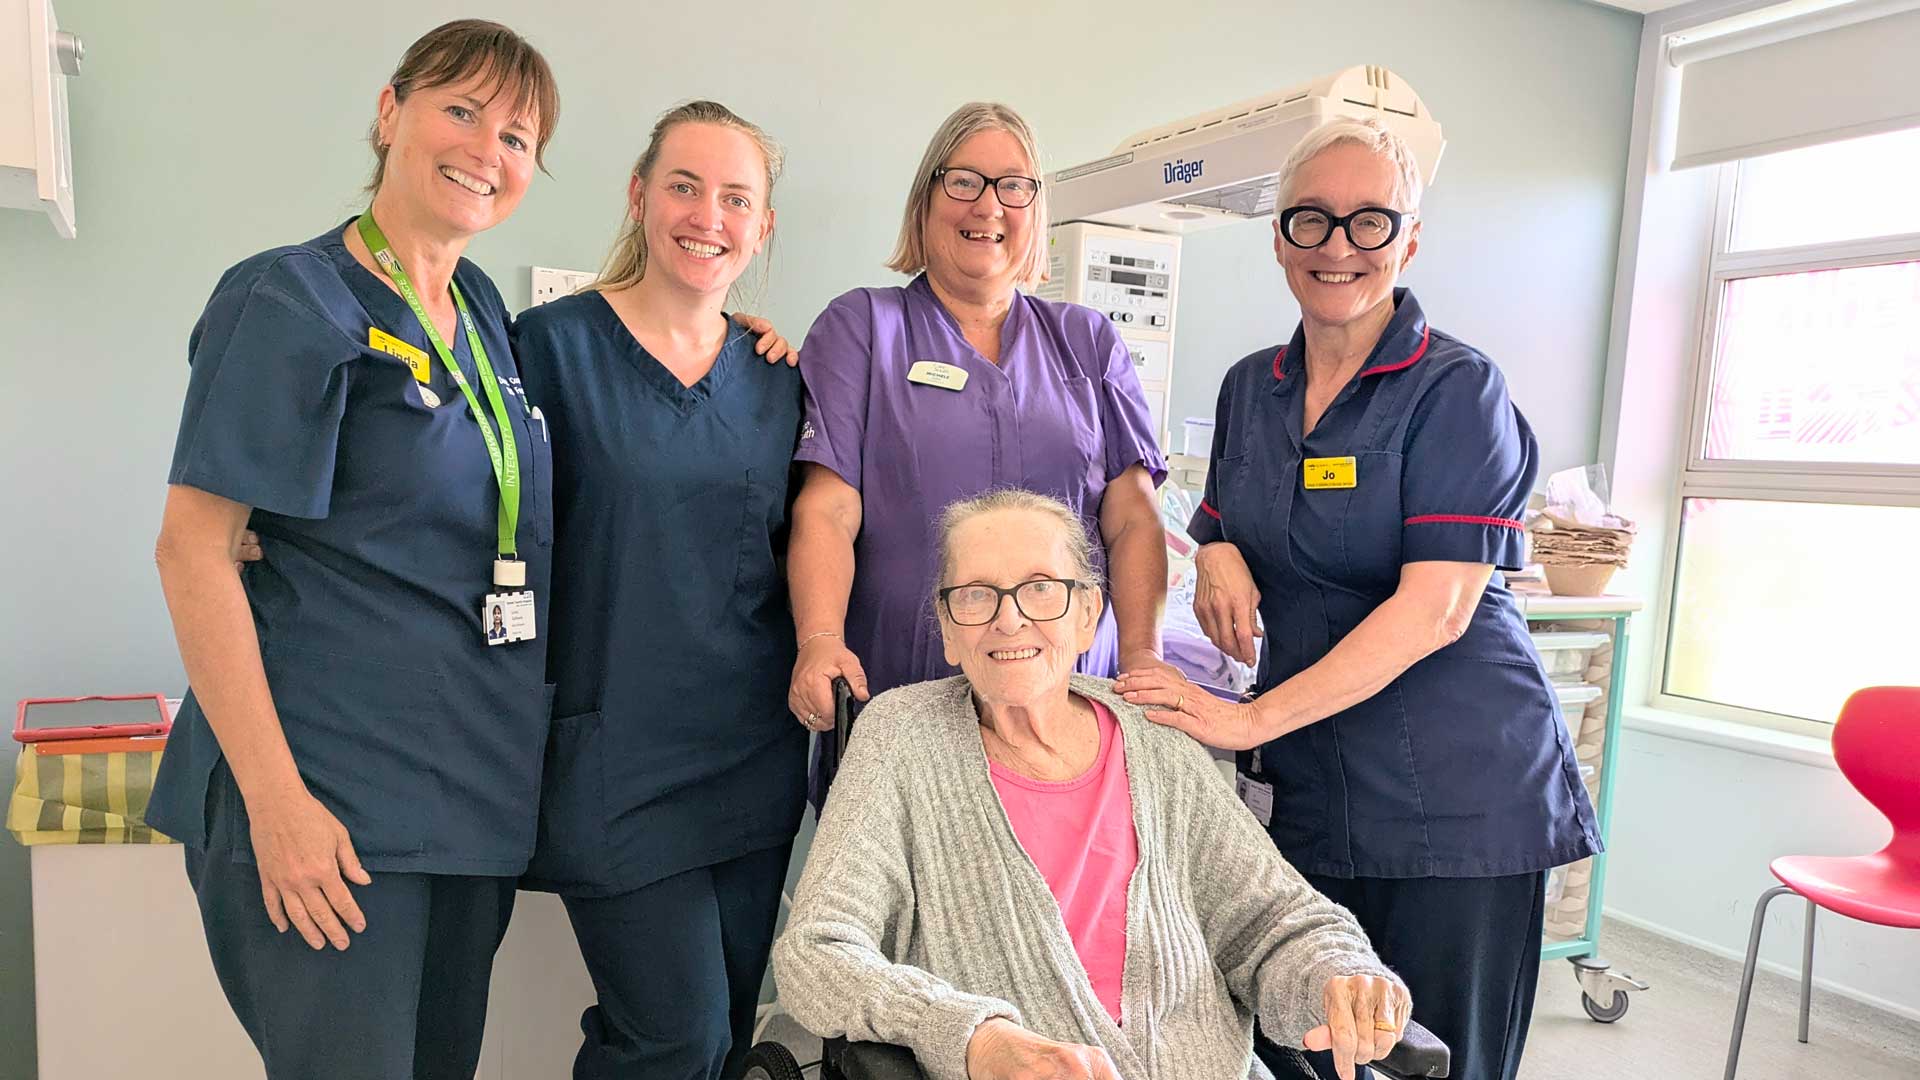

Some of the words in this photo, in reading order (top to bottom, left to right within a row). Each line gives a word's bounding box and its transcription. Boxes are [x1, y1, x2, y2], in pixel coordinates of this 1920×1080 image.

[1164, 159, 1204, 184] Dräger
[397, 279, 440, 341] EXCELLENCE
[384, 345, 419, 370] Linda
[502, 426, 516, 488] INTEGRITY
[1322, 470, 1336, 480] Jo
